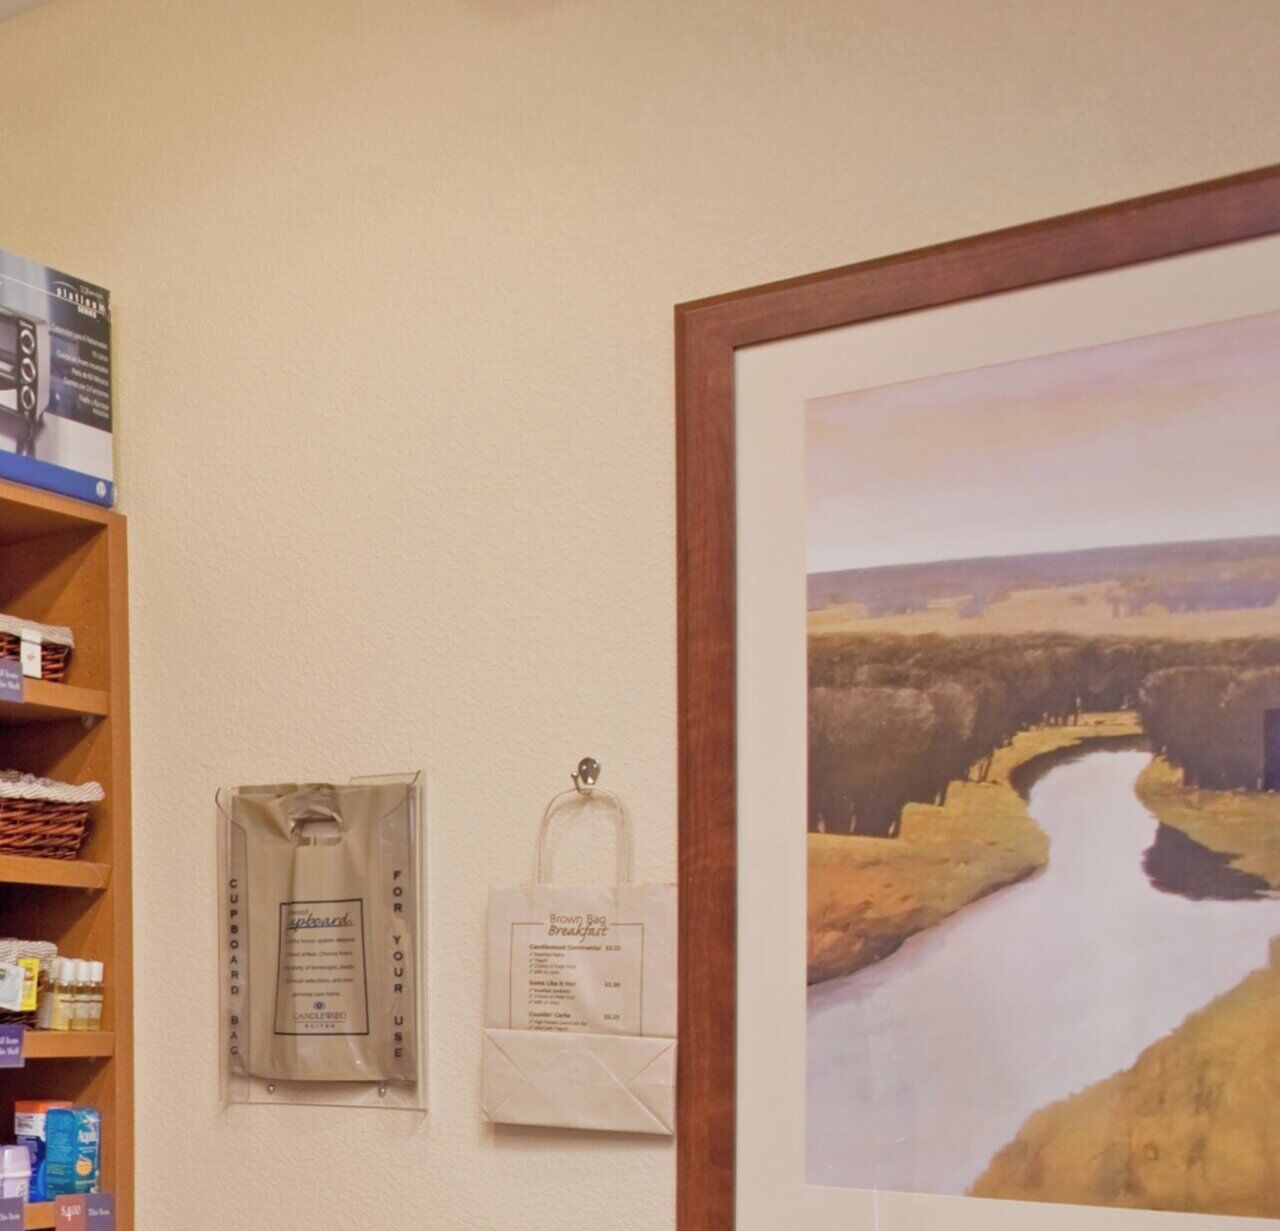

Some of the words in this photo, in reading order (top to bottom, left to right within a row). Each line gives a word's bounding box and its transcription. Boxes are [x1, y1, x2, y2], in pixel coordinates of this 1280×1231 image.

[393, 870, 403, 913] FOR
[229, 878, 239, 995] CUPBOARD
[548, 922, 609, 943] Breakfast
[550, 913, 582, 924] Brown
[586, 913, 606, 926] Bag
[393, 934, 403, 993] YOUR
[230, 1015, 239, 1056] BAG
[394, 1016, 403, 1058] USE
